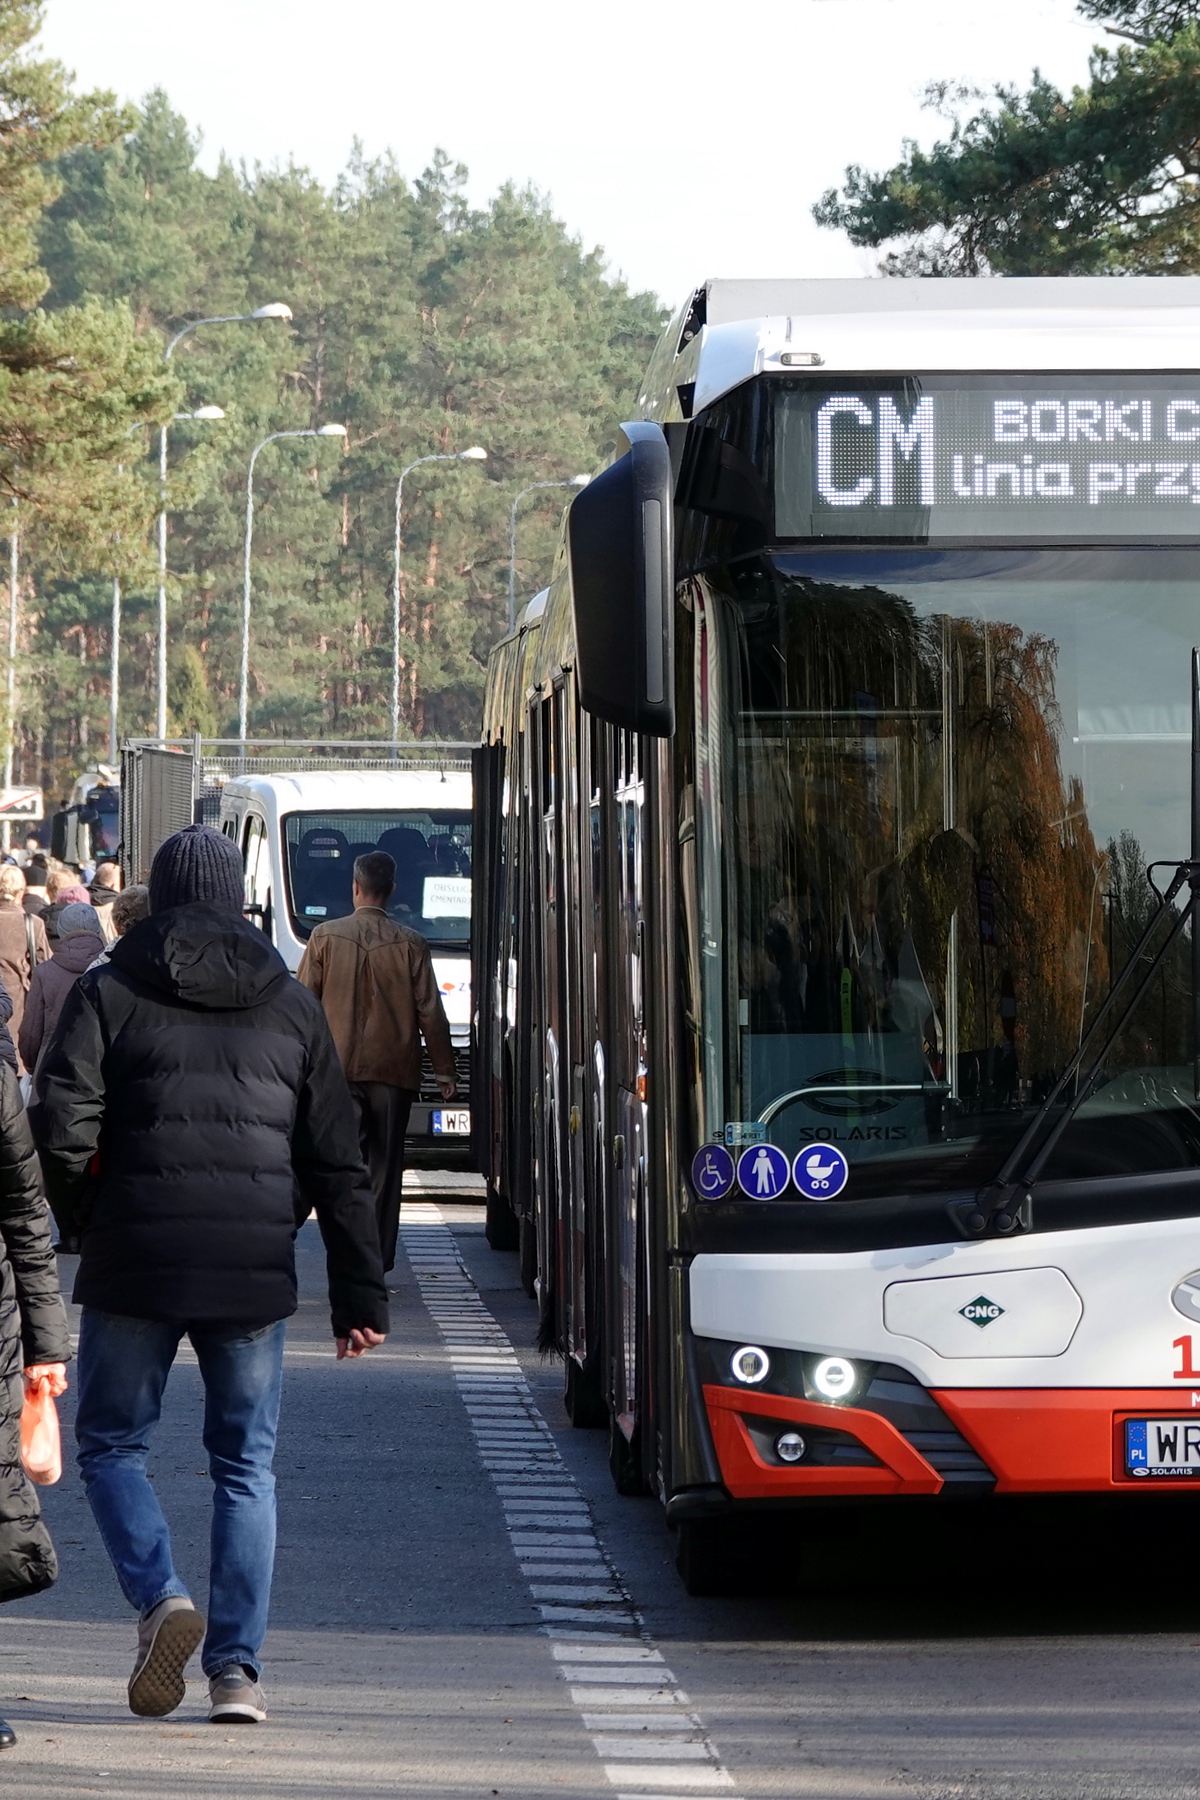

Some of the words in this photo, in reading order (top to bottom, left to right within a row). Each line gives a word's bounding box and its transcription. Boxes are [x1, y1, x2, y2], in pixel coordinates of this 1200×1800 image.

[994, 400, 1151, 442] BORKI
[817, 396, 934, 506] CM
[953, 454, 1073, 496] linia
[446, 1113, 469, 1131] WR
[799, 1126, 907, 1141] SOLARIS
[963, 1305, 1000, 1319] CNG
[1131, 1449, 1146, 1461] PL
[1150, 1467, 1193, 1475] SOLARIS
